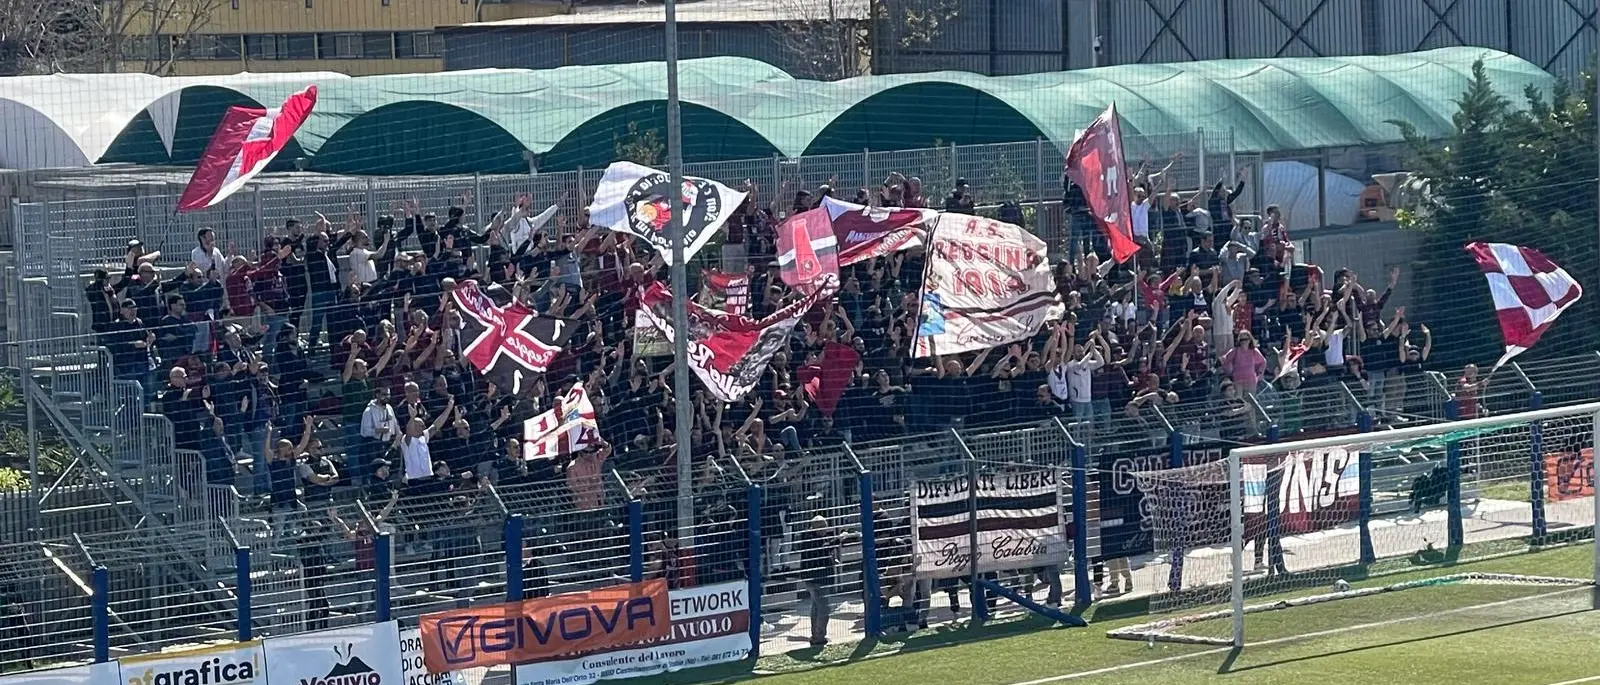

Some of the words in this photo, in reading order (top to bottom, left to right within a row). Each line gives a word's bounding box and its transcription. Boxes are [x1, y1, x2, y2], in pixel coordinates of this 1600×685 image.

[917, 473, 996, 499] DIFFIDTI
[1005, 467, 1058, 491] LIBERI
[934, 541, 983, 573] Reggo
[991, 534, 1048, 561] Calabria
[670, 589, 743, 616] ETWORK
[480, 596, 656, 655] GIVOVA
[677, 615, 733, 639] VUOLO
[637, 651, 654, 663] del
